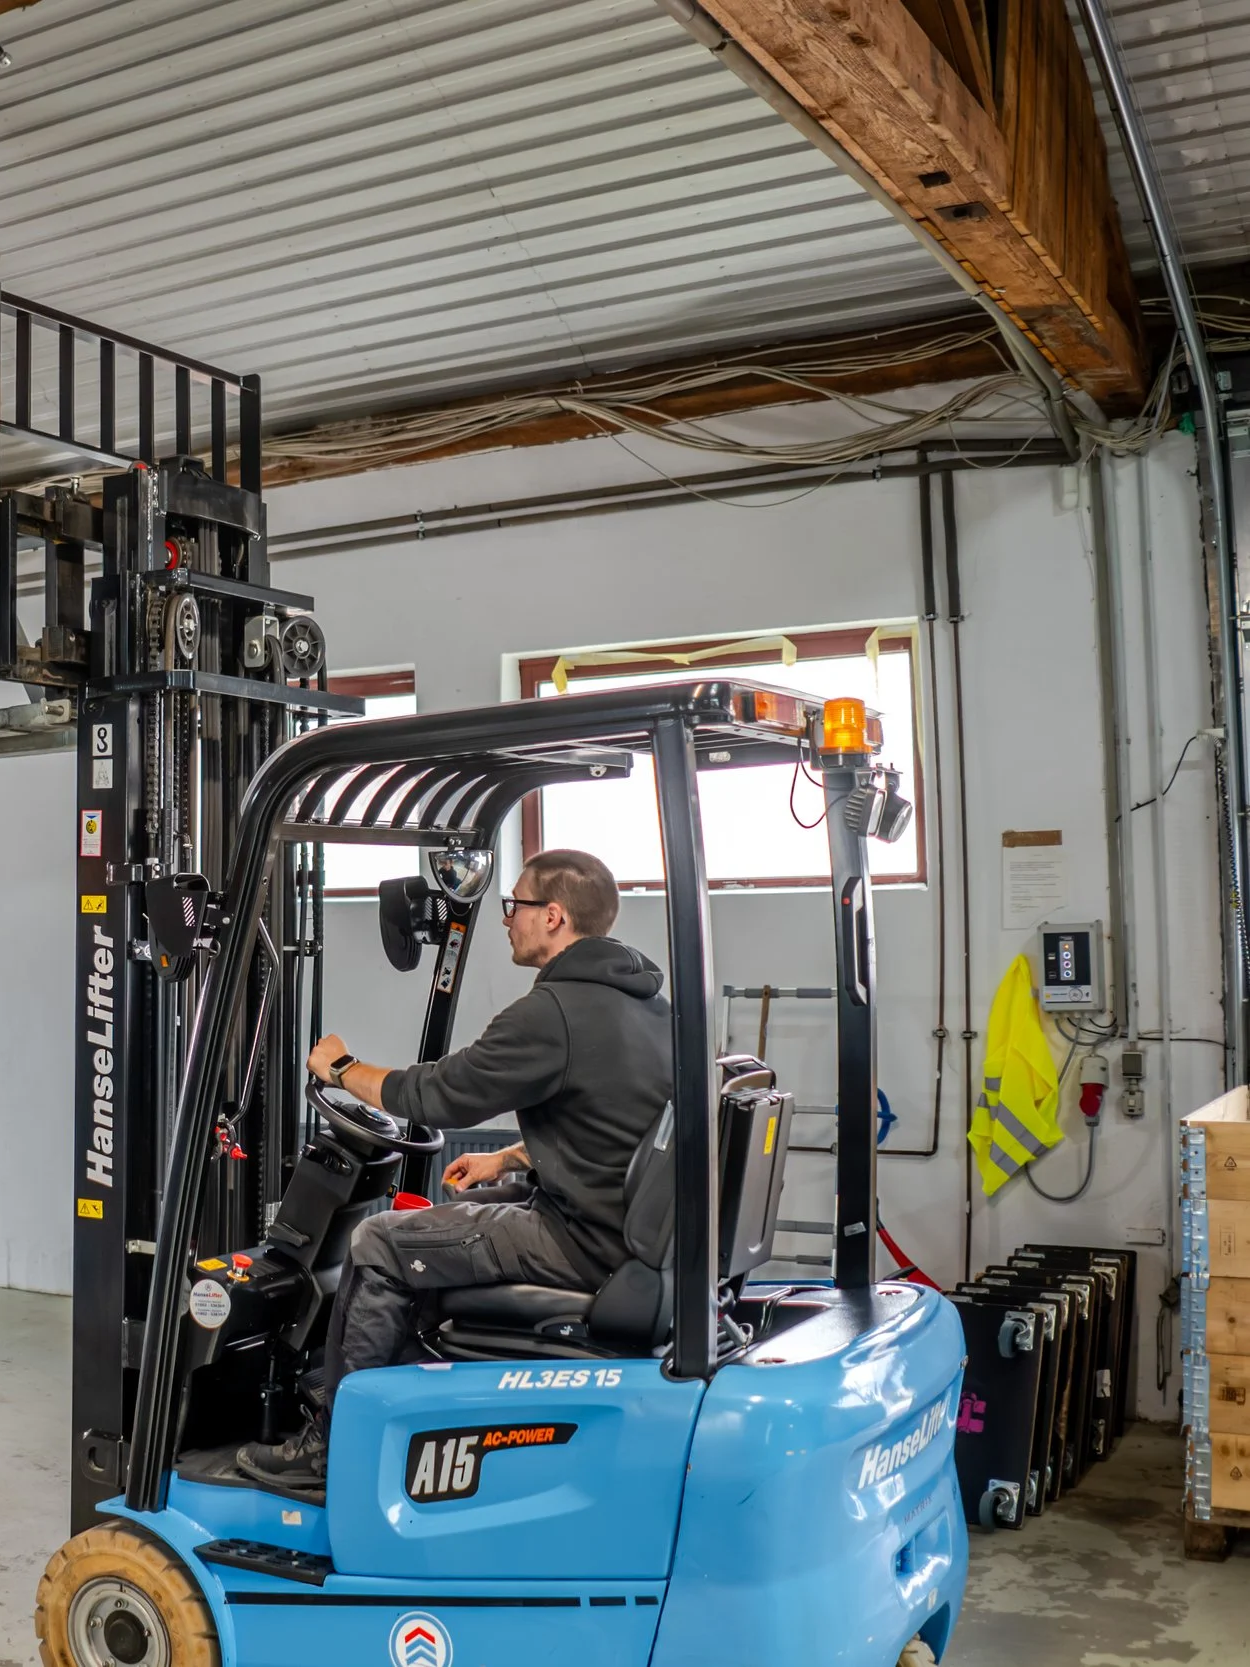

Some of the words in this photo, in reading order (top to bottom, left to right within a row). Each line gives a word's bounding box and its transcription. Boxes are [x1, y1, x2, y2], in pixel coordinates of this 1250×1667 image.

[86, 925, 114, 1188] HanseLifter
[410, 1435, 479, 1496] A15
[482, 1427, 555, 1447] AC-POWER
